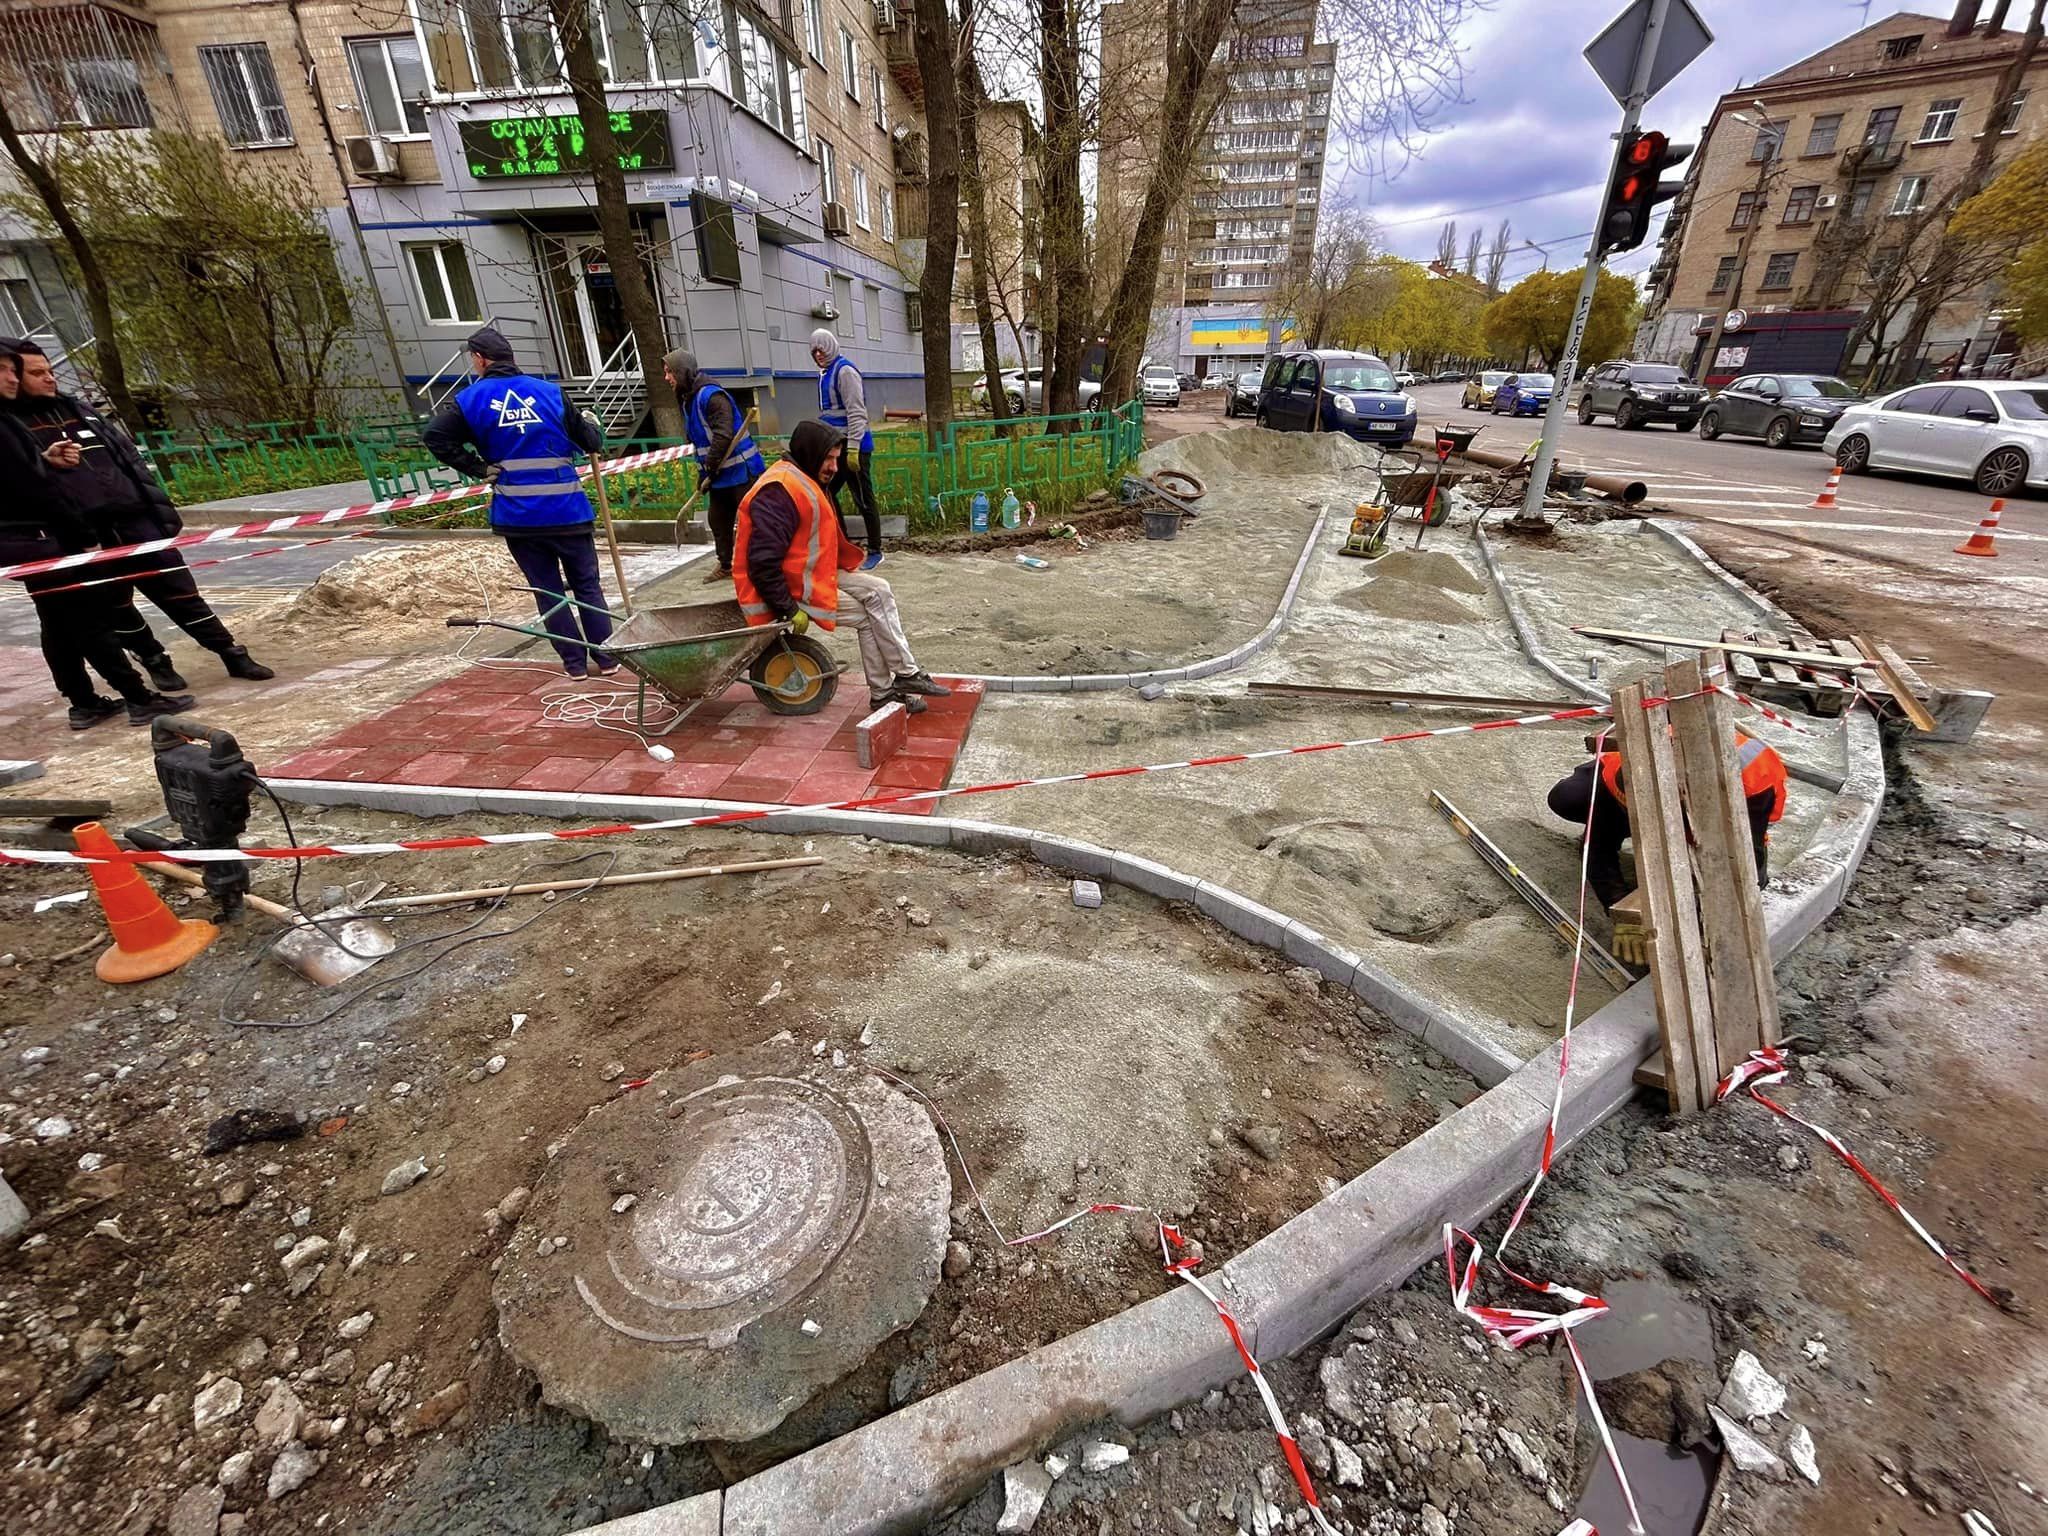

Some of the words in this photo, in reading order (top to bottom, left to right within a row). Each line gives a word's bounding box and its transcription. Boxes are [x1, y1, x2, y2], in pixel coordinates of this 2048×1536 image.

[491, 119, 558, 138] OCTAVA
[560, 113, 632, 135] FINCE
[505, 407, 532, 420] БУД
[517, 424, 526, 434] Т
